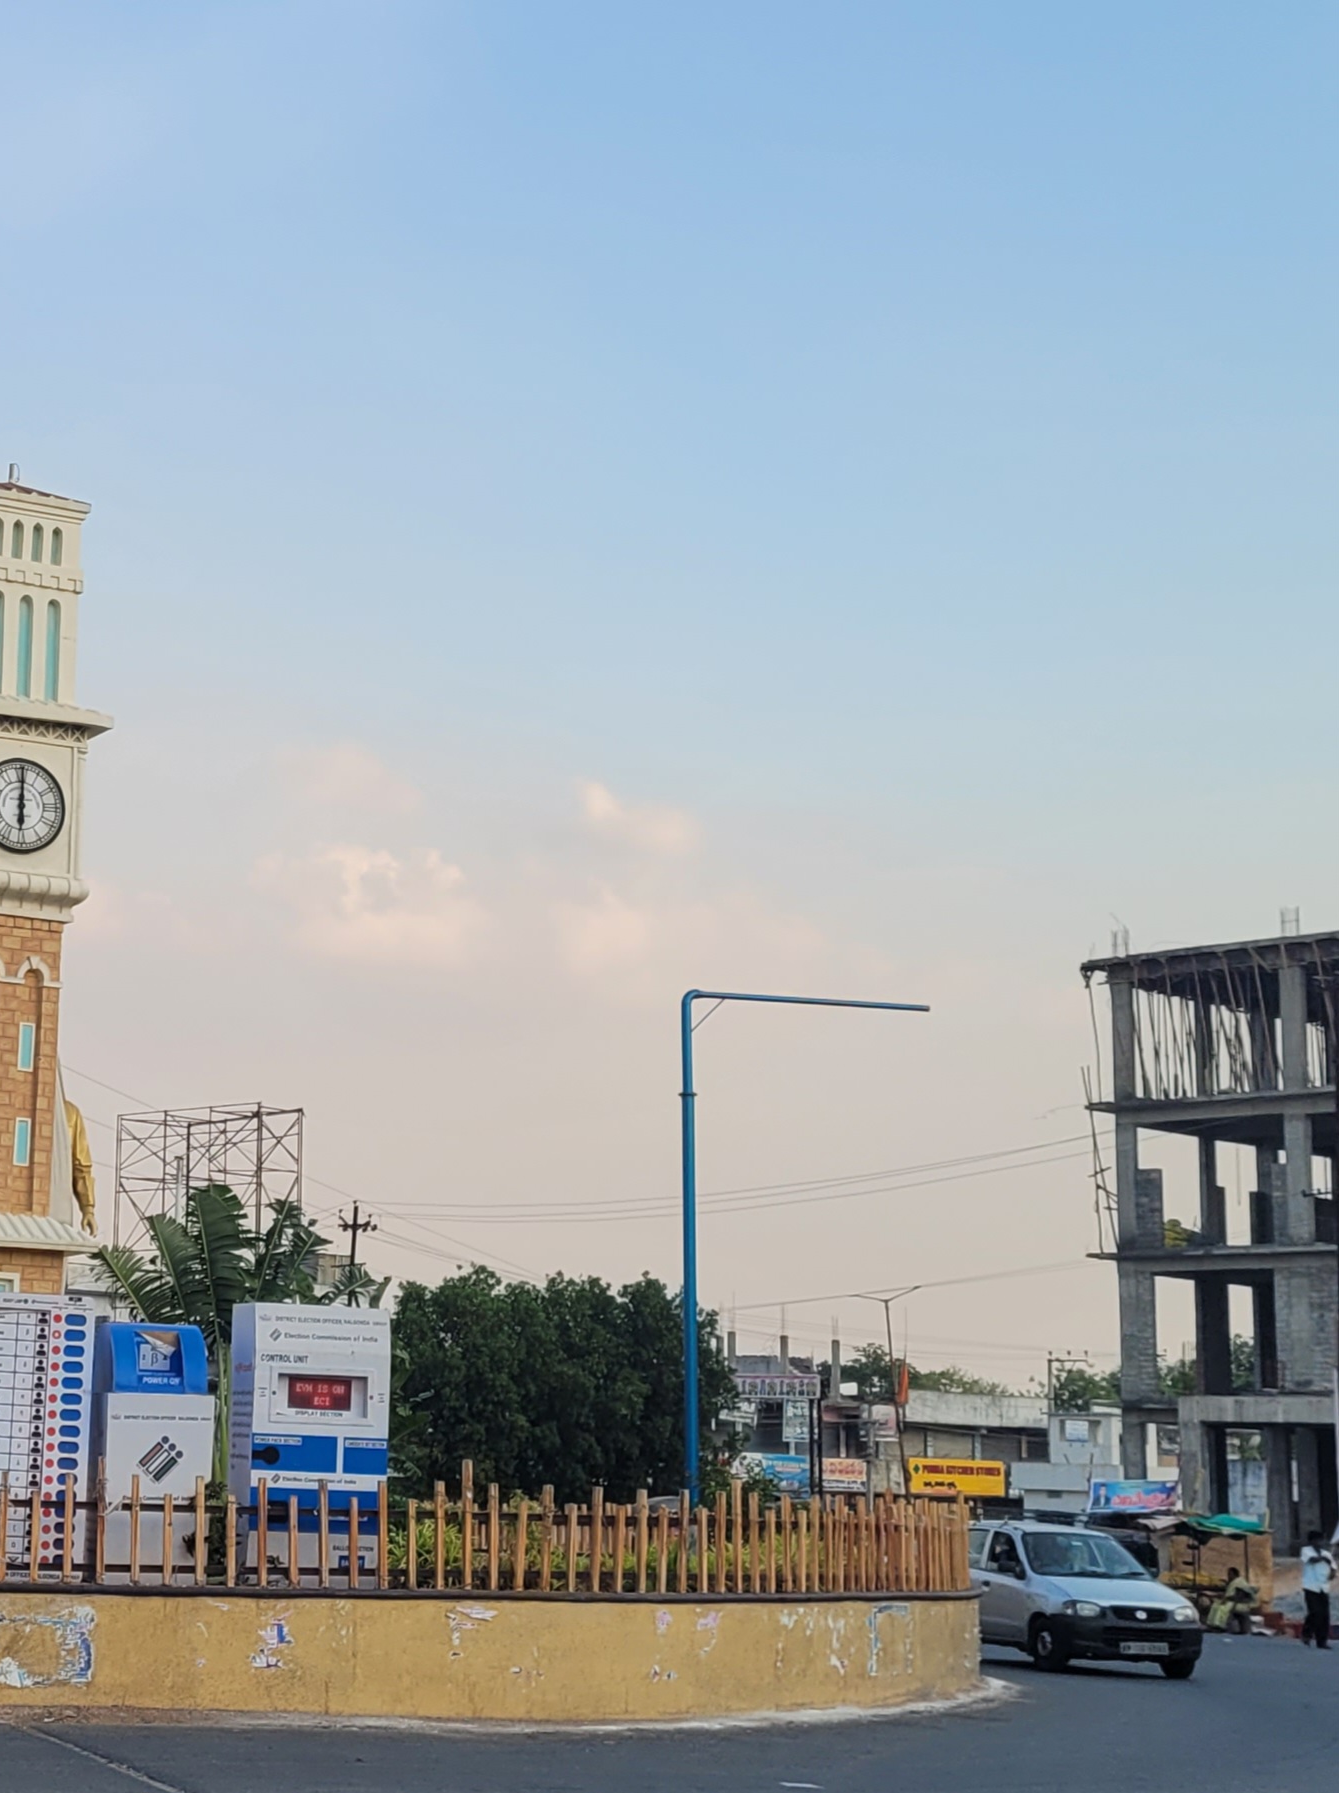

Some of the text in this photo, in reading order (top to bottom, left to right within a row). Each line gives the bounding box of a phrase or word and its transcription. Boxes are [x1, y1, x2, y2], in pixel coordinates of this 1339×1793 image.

[284, 1332, 310, 1340] Election
[312, 1333, 351, 1342] Commission
[261, 1354, 309, 1364] CONTROL UNIT
[142, 1377, 181, 1385] POWER ON
[318, 1384, 328, 1394] IS
[314, 1397, 330, 1406] ECI
